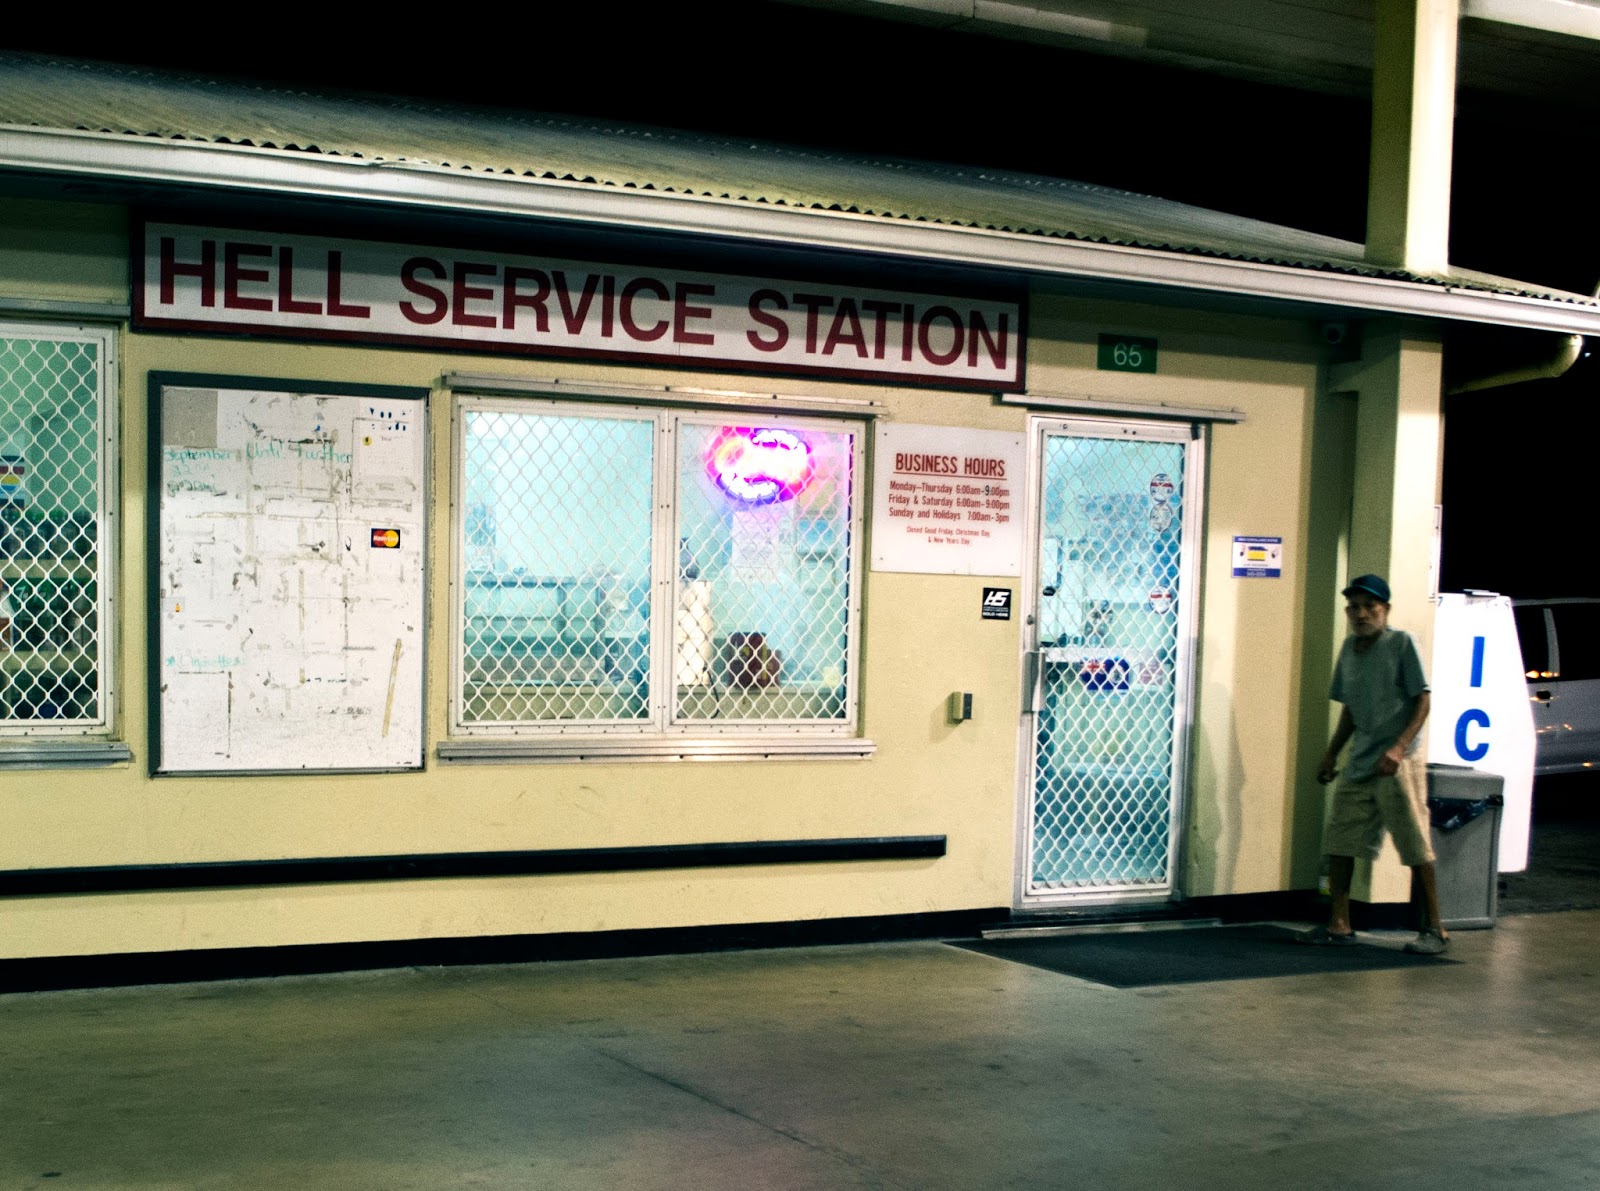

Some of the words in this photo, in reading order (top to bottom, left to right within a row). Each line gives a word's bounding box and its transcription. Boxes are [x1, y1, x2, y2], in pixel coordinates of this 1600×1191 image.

[160, 237, 371, 319] HELL
[399, 256, 716, 346] SERVICE
[746, 288, 1009, 370] STATION
[1113, 342, 1142, 367] 65
[895, 452, 958, 474] BUSINESS
[964, 456, 1006, 477] HOURS
[888, 493, 910, 506] Friday
[913, 495, 919, 505] &
[921, 495, 953, 508] Saturday
[888, 506, 914, 520] Sunday
[917, 508, 930, 518] and
[932, 509, 961, 522] Holidays
[906, 526, 923, 534] Closed
[924, 526, 938, 535] Good
[955, 528, 979, 537] Christmas
